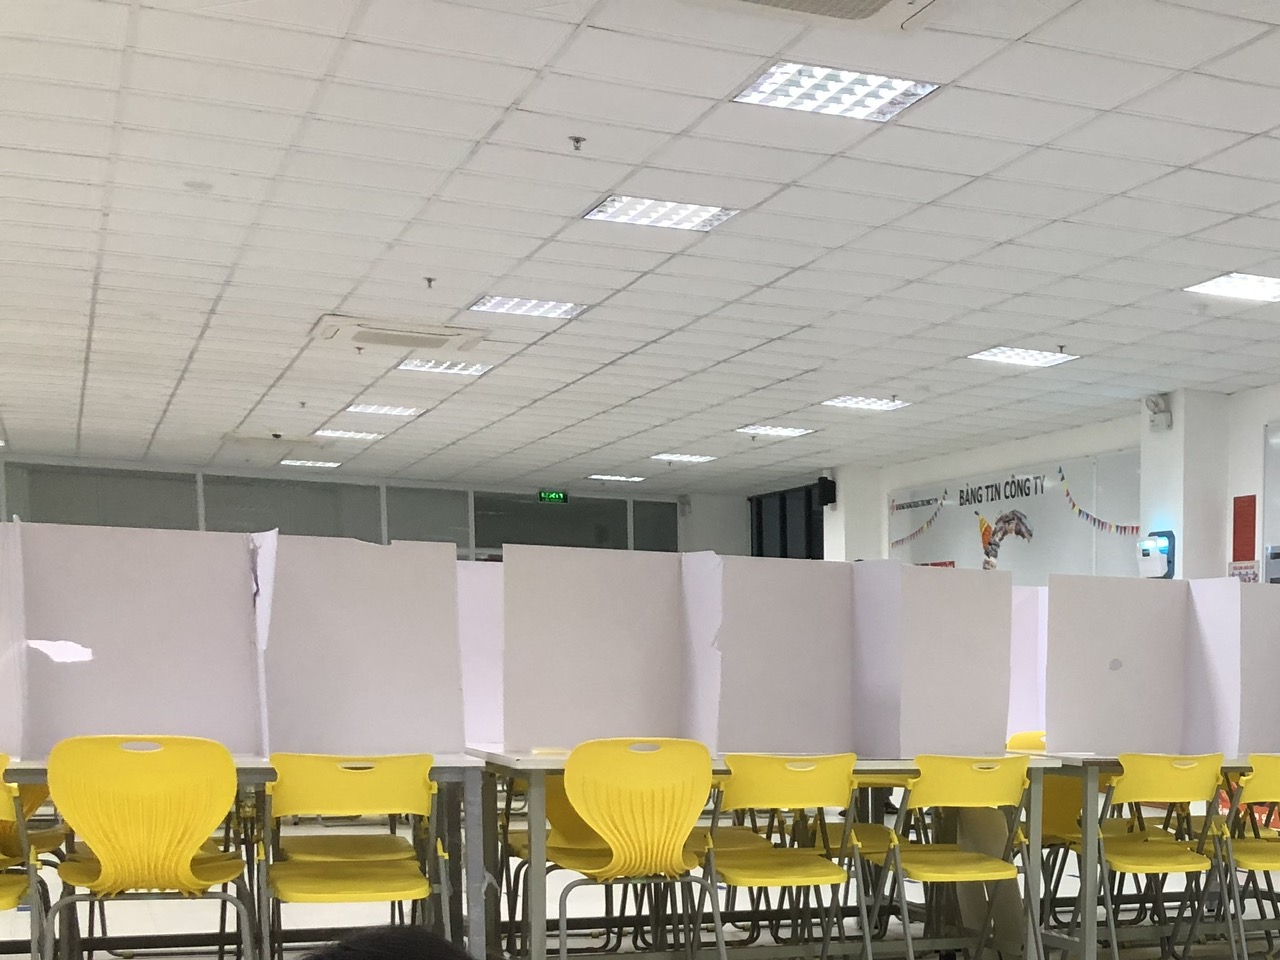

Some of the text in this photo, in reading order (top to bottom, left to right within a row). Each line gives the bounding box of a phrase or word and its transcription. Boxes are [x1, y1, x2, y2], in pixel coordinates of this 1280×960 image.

[984, 482, 1001, 502] TIN
[1003, 474, 1031, 500] CÔNG
[1032, 474, 1046, 496] TY
